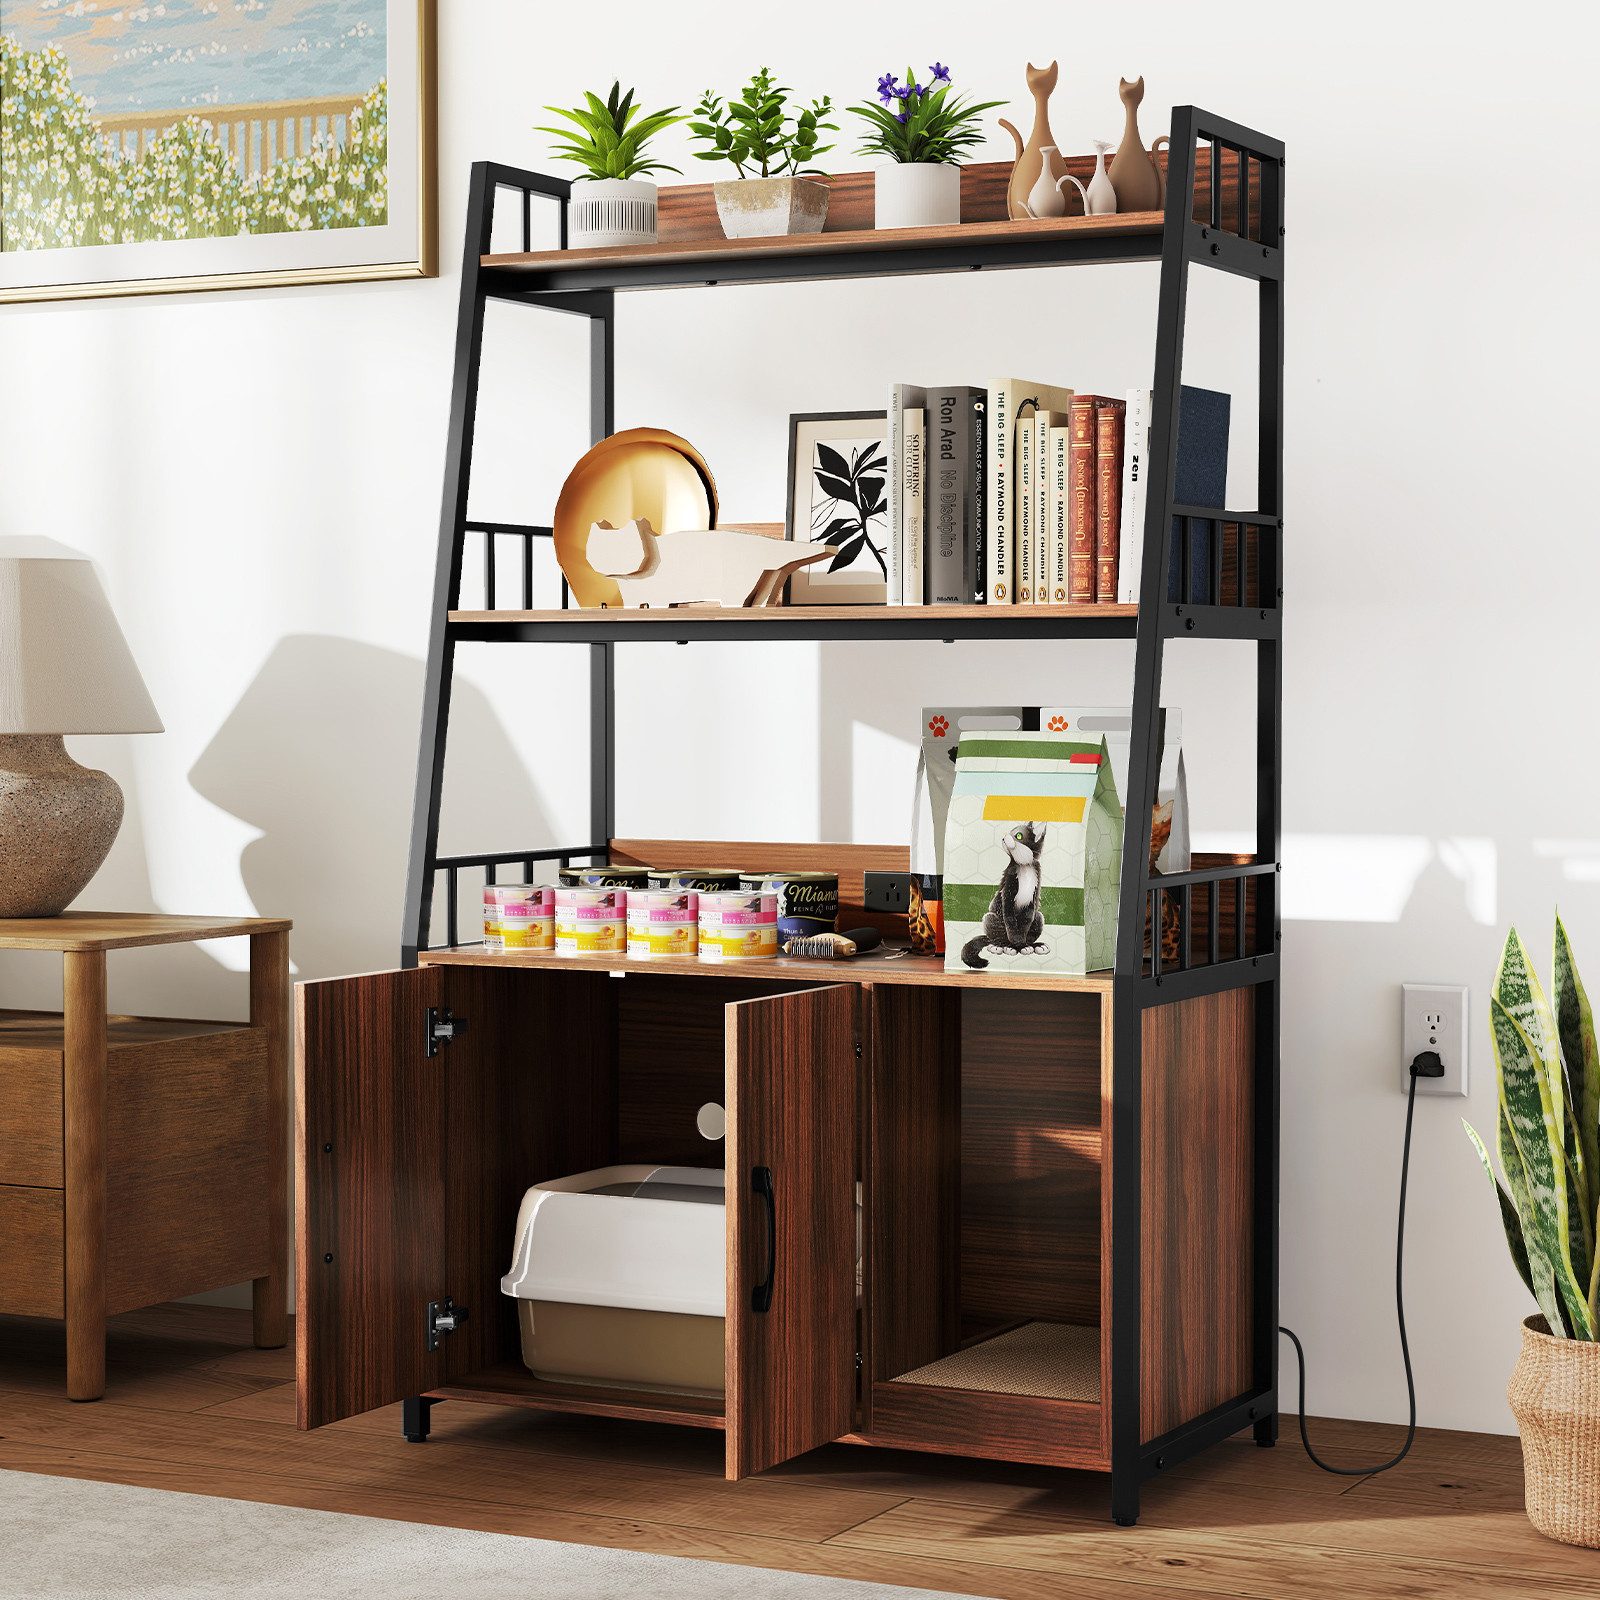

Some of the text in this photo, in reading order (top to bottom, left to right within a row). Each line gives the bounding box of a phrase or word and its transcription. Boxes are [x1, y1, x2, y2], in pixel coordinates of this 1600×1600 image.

[1133, 388, 1141, 447] simply
[905, 434, 913, 491] FOR GLORY
[912, 434, 920, 498] SOLDIERING
[937, 397, 956, 558] Ron Arad No Discipline
[976, 460, 982, 469] OF
[997, 392, 1005, 575] THE BIG SLEEP RAYMOND CHANDLER
